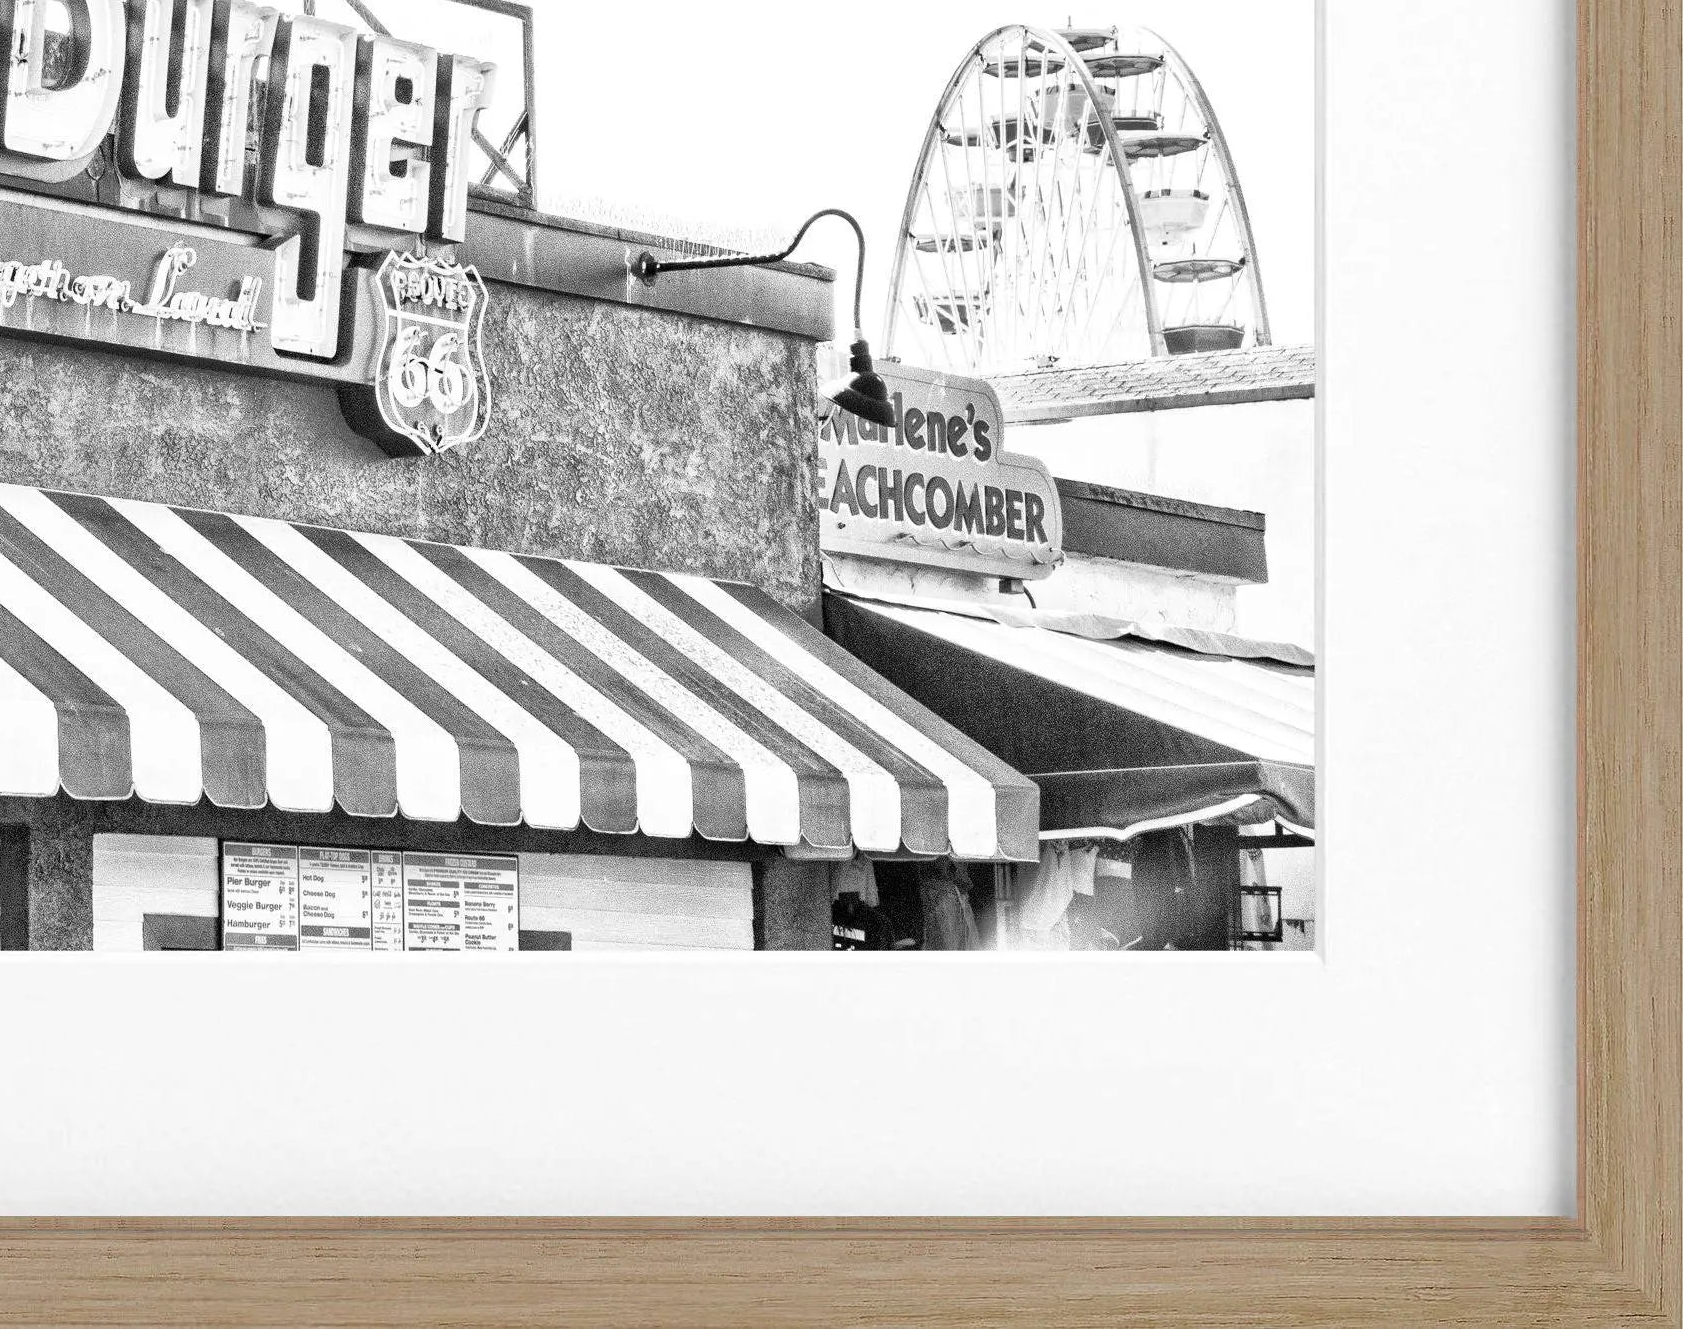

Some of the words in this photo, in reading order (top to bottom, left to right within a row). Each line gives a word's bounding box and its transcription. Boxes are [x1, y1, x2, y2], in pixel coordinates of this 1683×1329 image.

[132, 242, 268, 333] Land
[391, 324, 472, 414] 66
[227, 876, 243, 886] Pier
[244, 877, 271, 889] Burger
[302, 874, 313, 882] Hot
[313, 875, 324, 883] Dog
[302, 889, 324, 898] Cheese
[325, 890, 336, 899] Dog
[227, 900, 254, 911] Veggie
[255, 901, 283, 912] Burger
[323, 911, 335, 919] Dog
[227, 919, 271, 931] Hamburger
